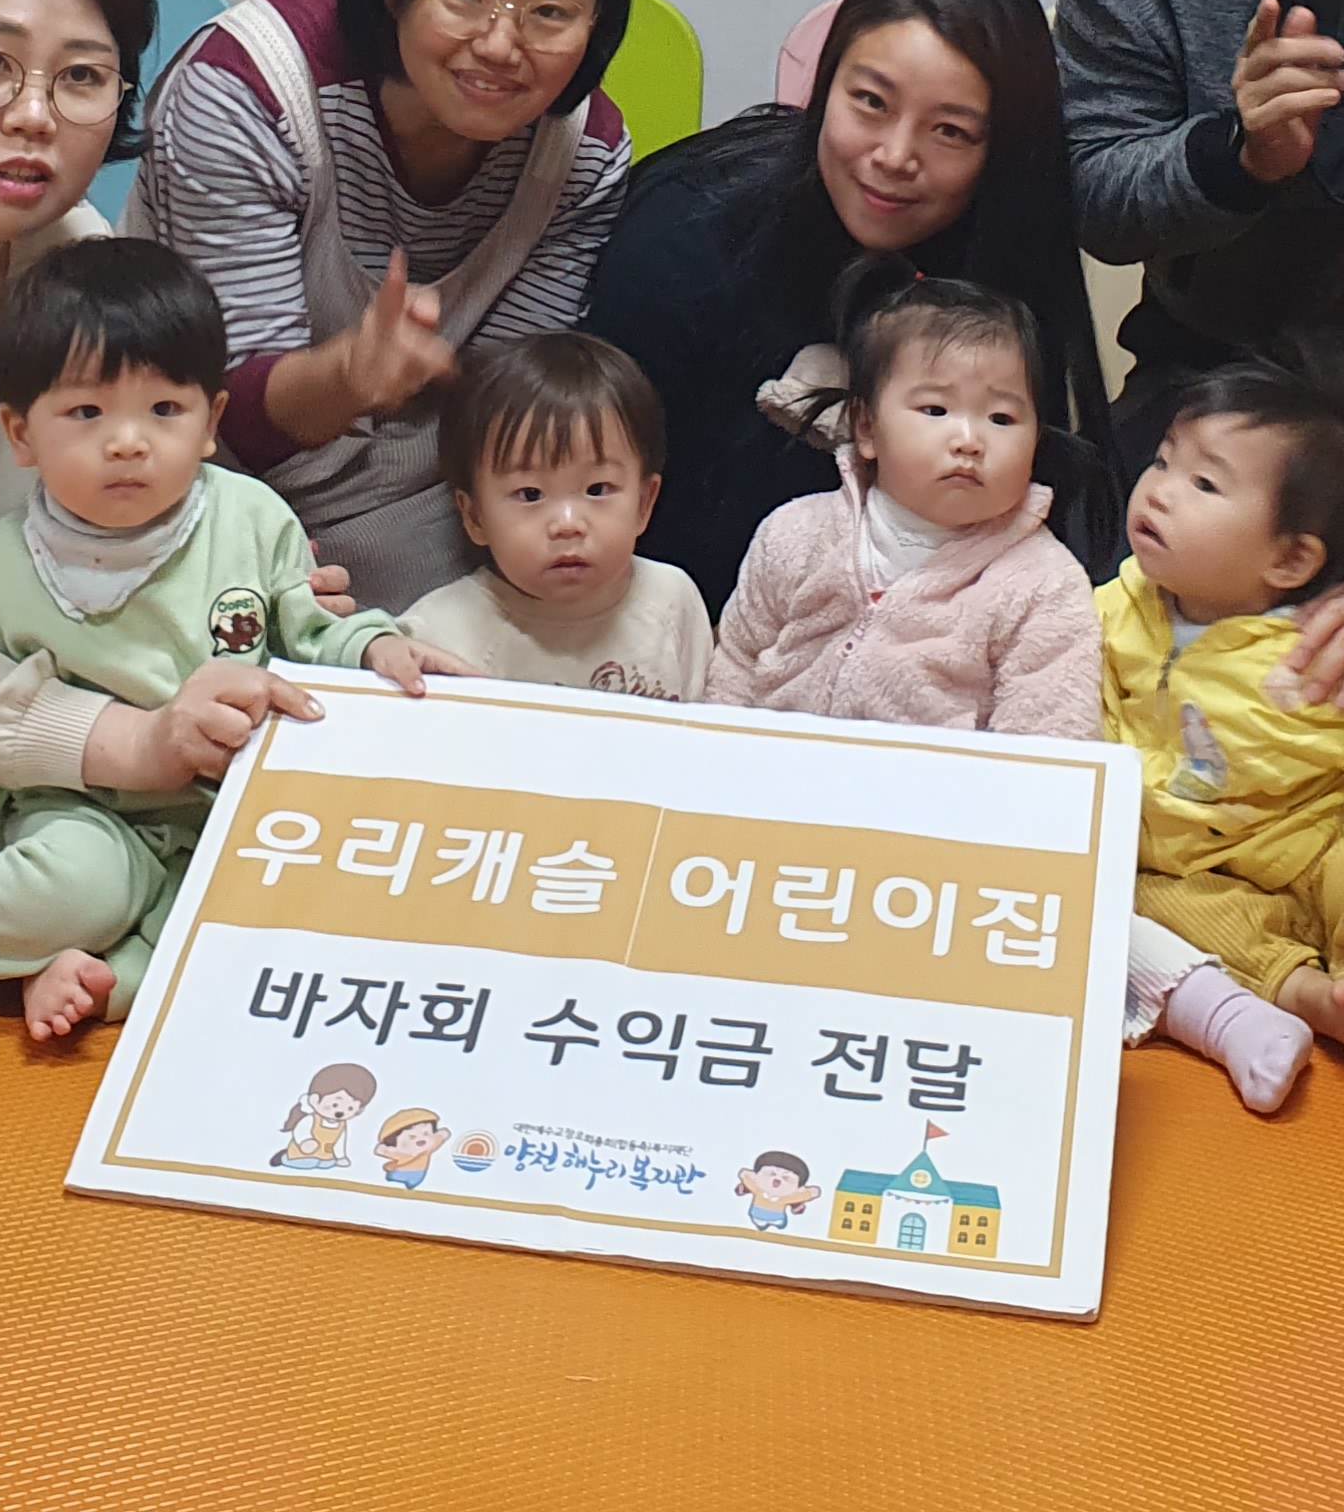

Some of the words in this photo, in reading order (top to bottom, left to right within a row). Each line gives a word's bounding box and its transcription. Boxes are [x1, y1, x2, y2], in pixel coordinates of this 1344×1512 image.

[236, 808, 619, 915] 우리캐슬
[668, 854, 1063, 970] 어린이집
[248, 966, 492, 1052] 바자회
[523, 997, 775, 1088] 수익금
[810, 1027, 983, 1113] 전달
[503, 1136, 559, 1173] 양천
[561, 1142, 627, 1191] 해누리
[628, 1153, 708, 1195] 복지관
